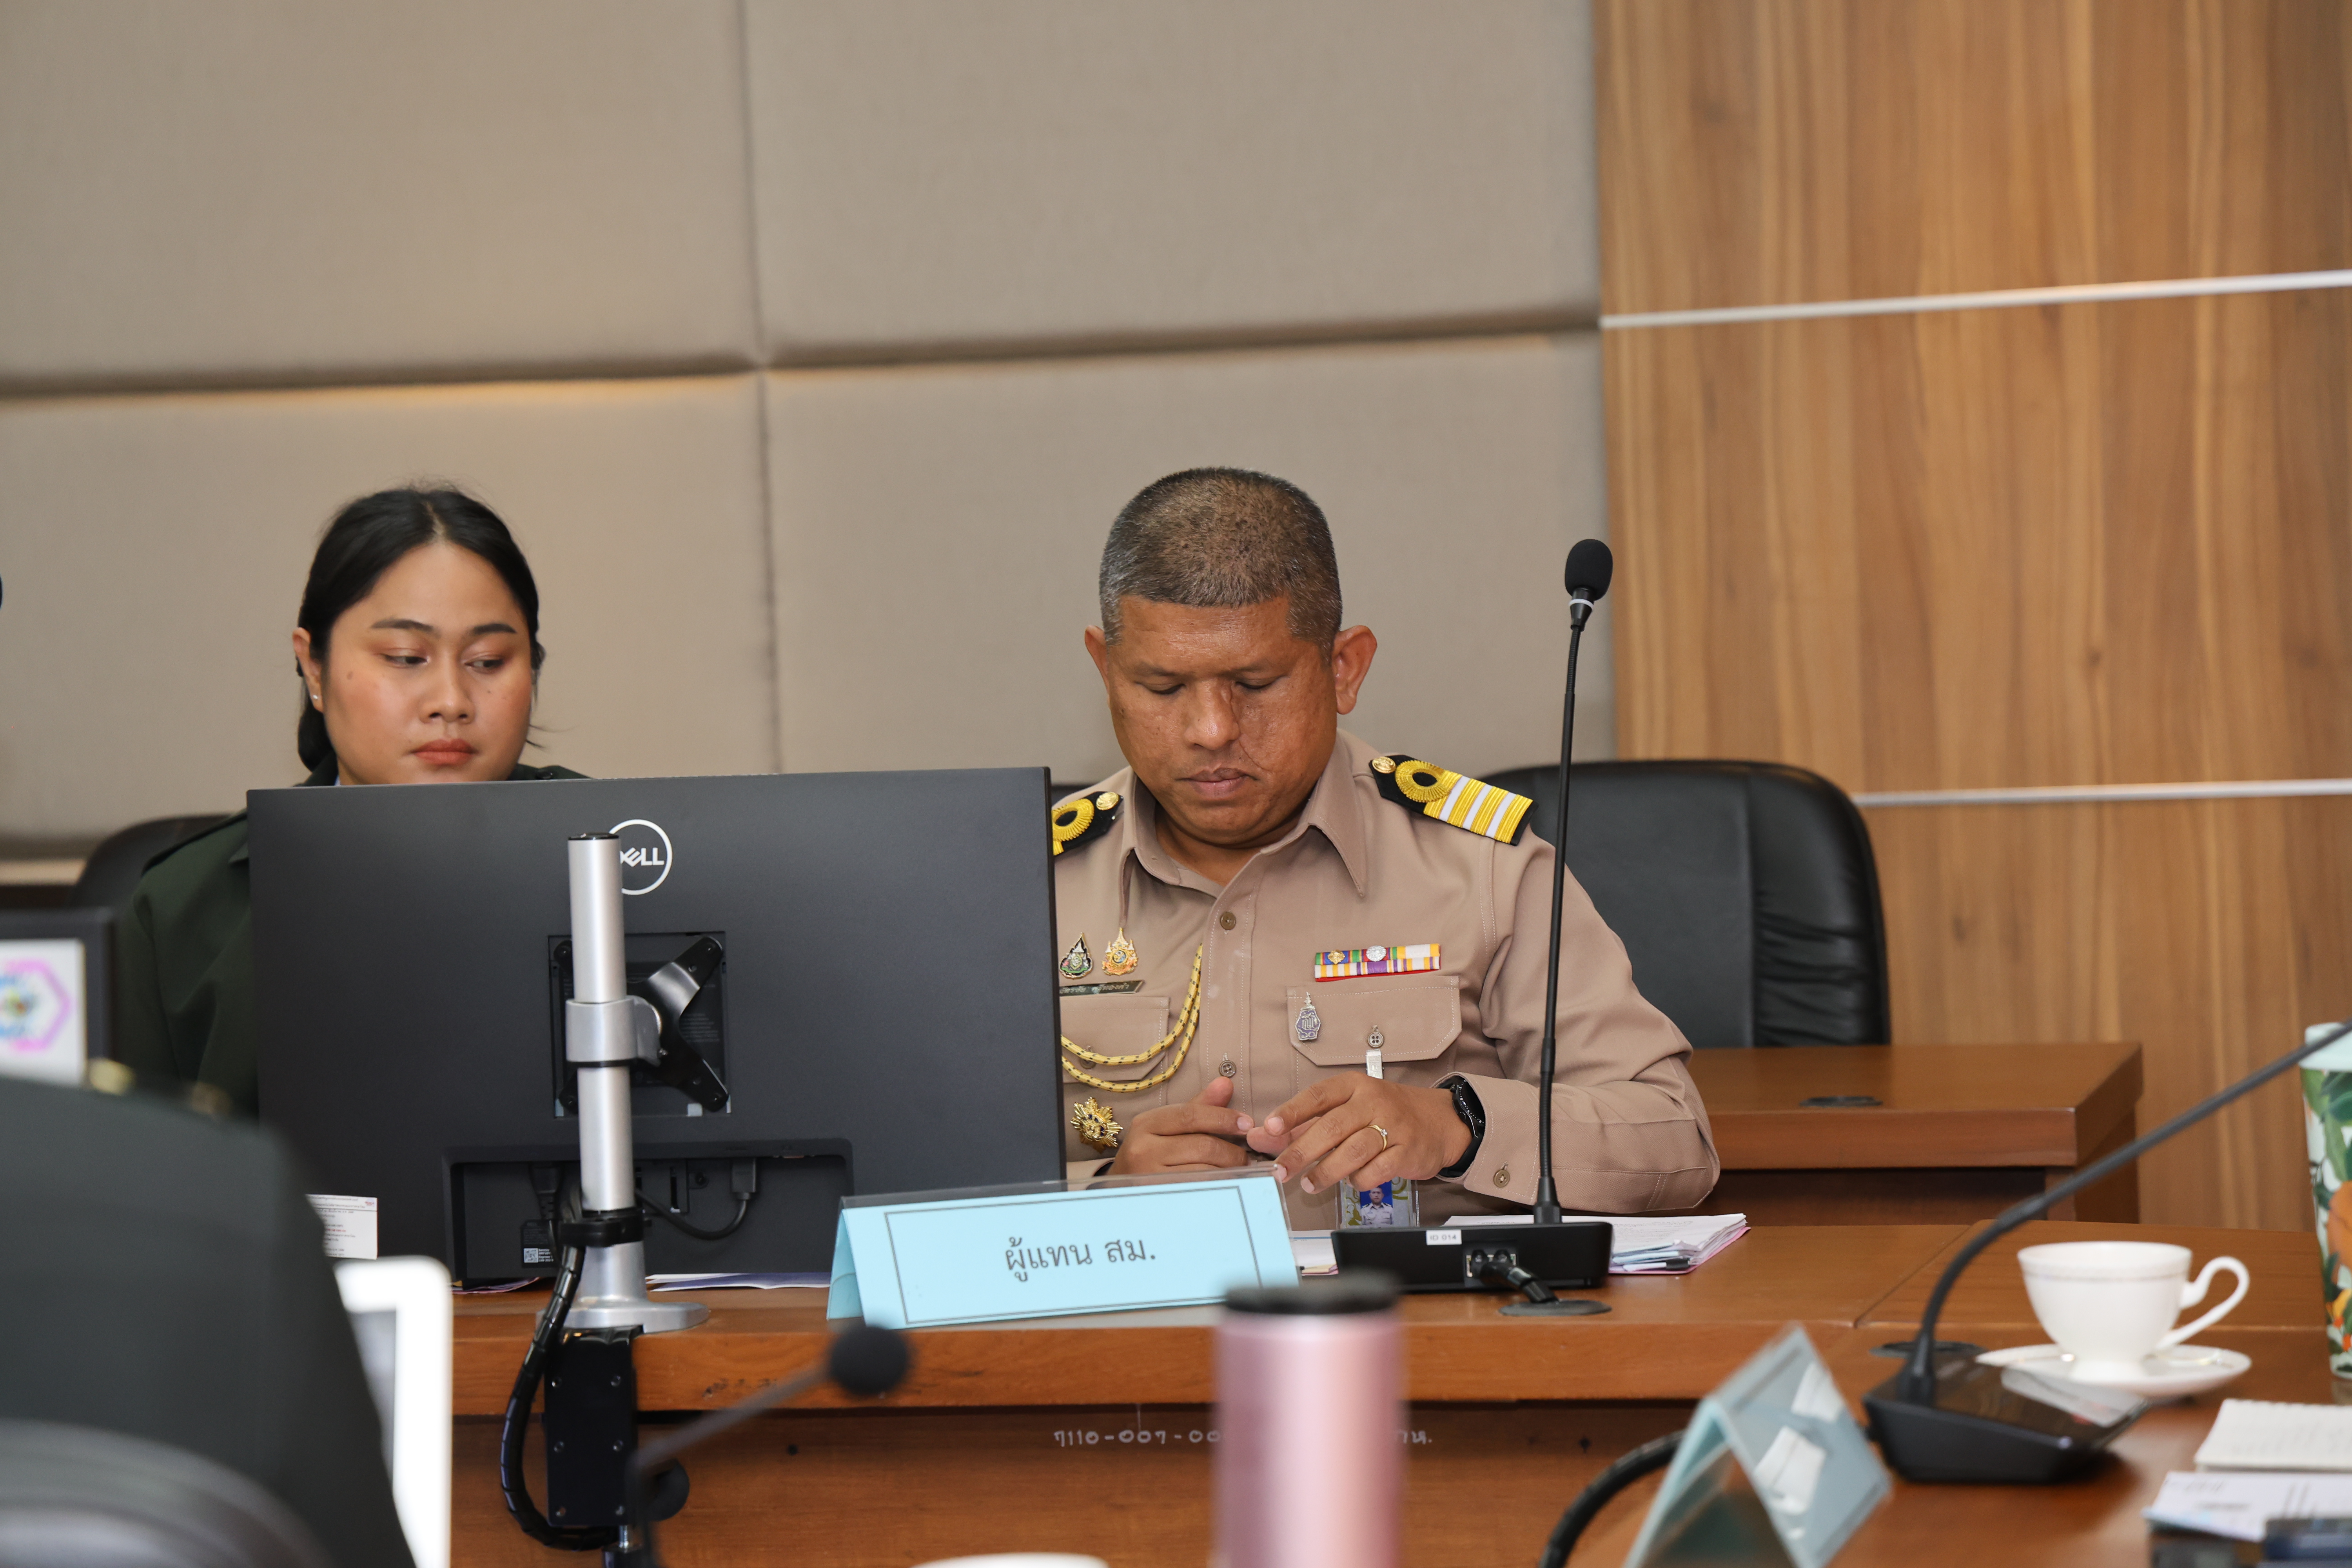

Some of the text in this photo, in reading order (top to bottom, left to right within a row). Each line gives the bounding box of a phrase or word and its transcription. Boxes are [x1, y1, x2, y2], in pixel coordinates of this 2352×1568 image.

[1005, 1236, 1156, 1282] ผู้แทน สม.
